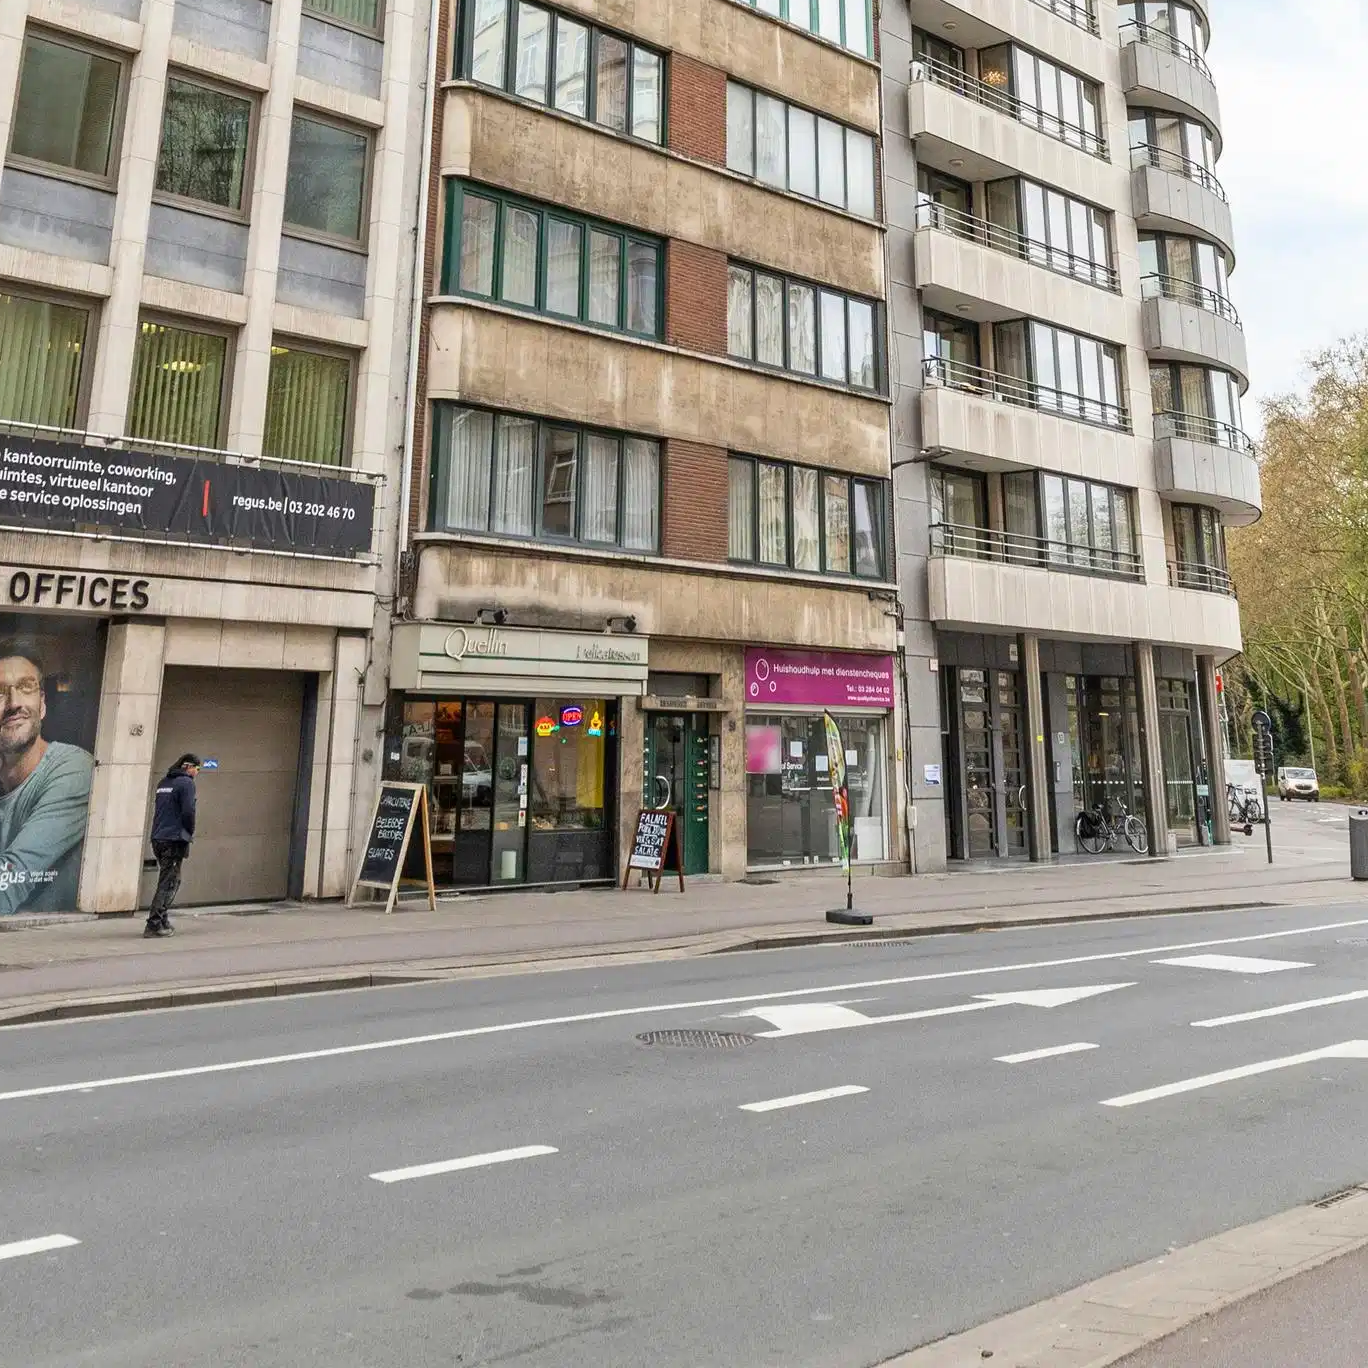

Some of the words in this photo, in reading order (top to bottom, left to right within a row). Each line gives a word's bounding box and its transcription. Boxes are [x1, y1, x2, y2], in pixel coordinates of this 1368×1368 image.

[3, 448, 105, 476] kantoorruimte,
[107, 463, 177, 484] coworking,
[49, 473, 101, 492] virtueel
[103, 478, 154, 498] kantoor
[10, 490, 60, 506] service
[62, 491, 142, 516] oplossingen
[232, 495, 283, 515] regus.be
[289, 500, 303, 514] 03
[304, 504, 325, 517] 202
[327, 506, 341, 519] 46
[341, 507, 356, 520] 70
[8, 571, 150, 610] OFFICES
[445, 627, 509, 661] Quellin
[773, 664, 821, 677] Huishoudhulp
[821, 667, 835, 676] met
[835, 668, 890, 681] dienstencheques
[562, 711, 582, 722] OPEN
